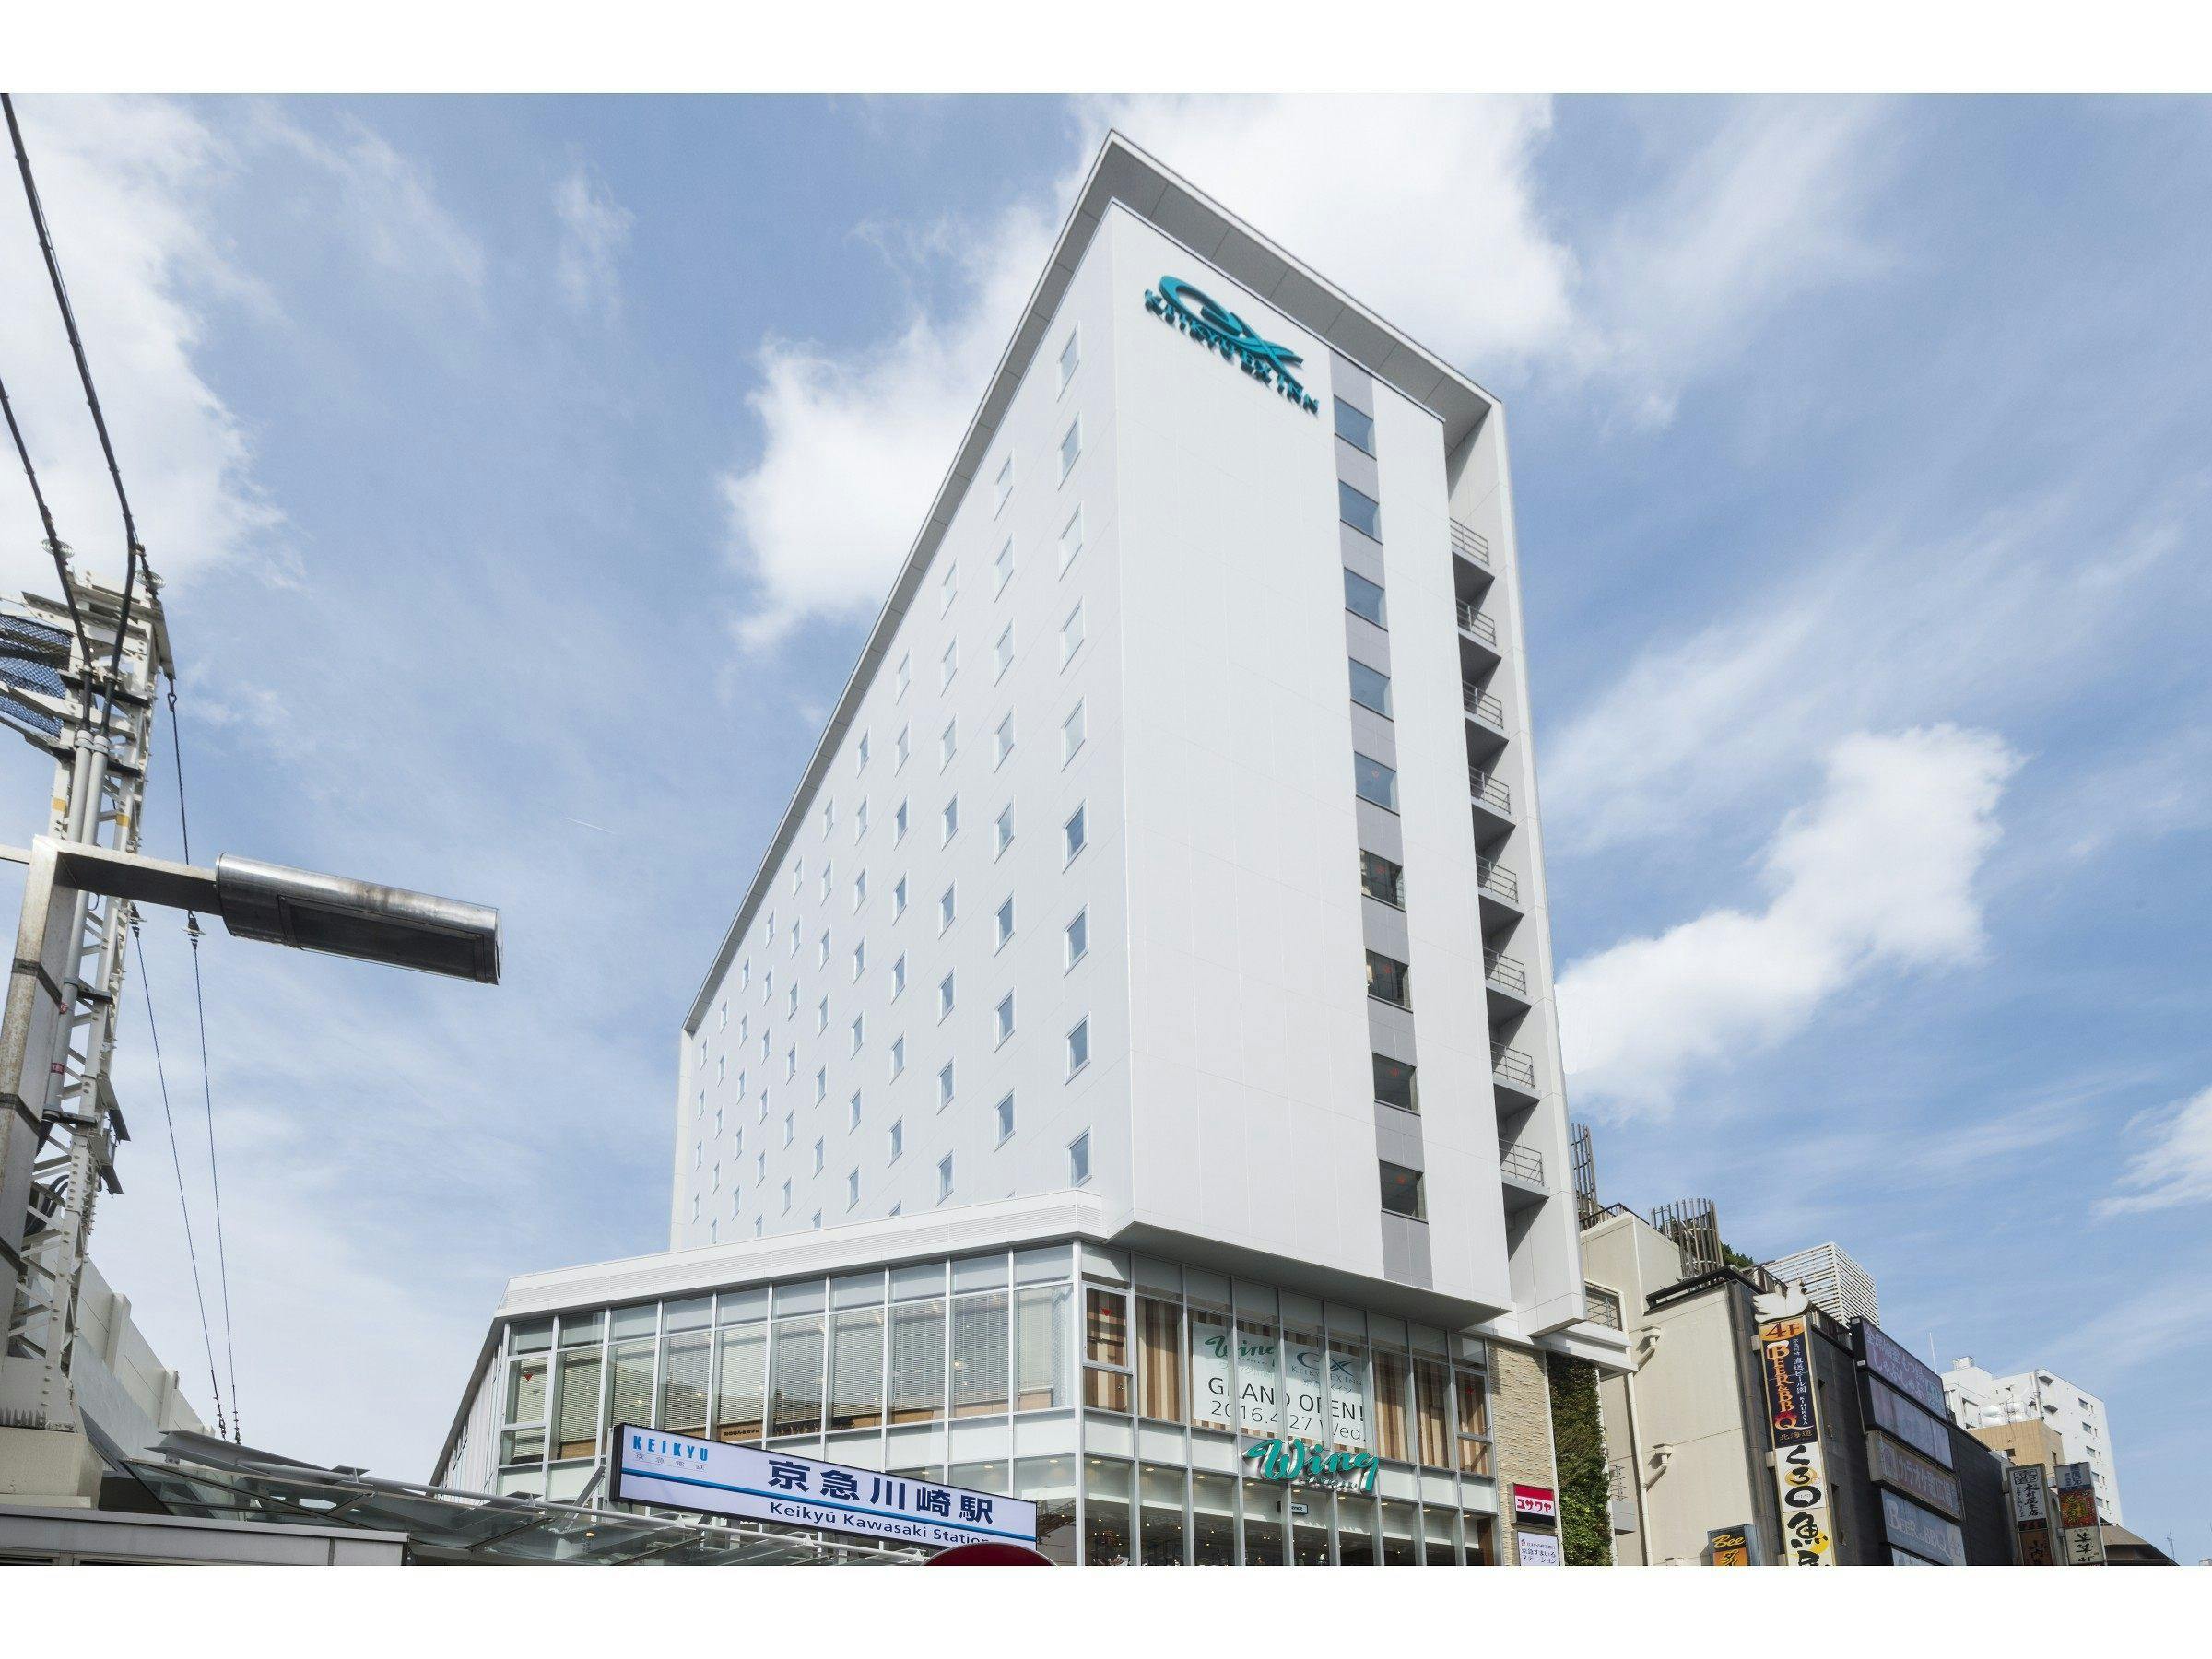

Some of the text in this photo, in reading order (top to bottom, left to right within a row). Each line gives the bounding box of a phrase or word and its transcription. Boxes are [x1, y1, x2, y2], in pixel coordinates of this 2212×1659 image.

[1766, 1322, 1799, 1338] 4F
[633, 1435, 709, 1462] KEIKYU
[1242, 1438, 1380, 1491] Wing
[768, 1460, 993, 1525] 京急川崎駅
[771, 1501, 836, 1524] Keikyū
[843, 1513, 927, 1538] Kawasaki
